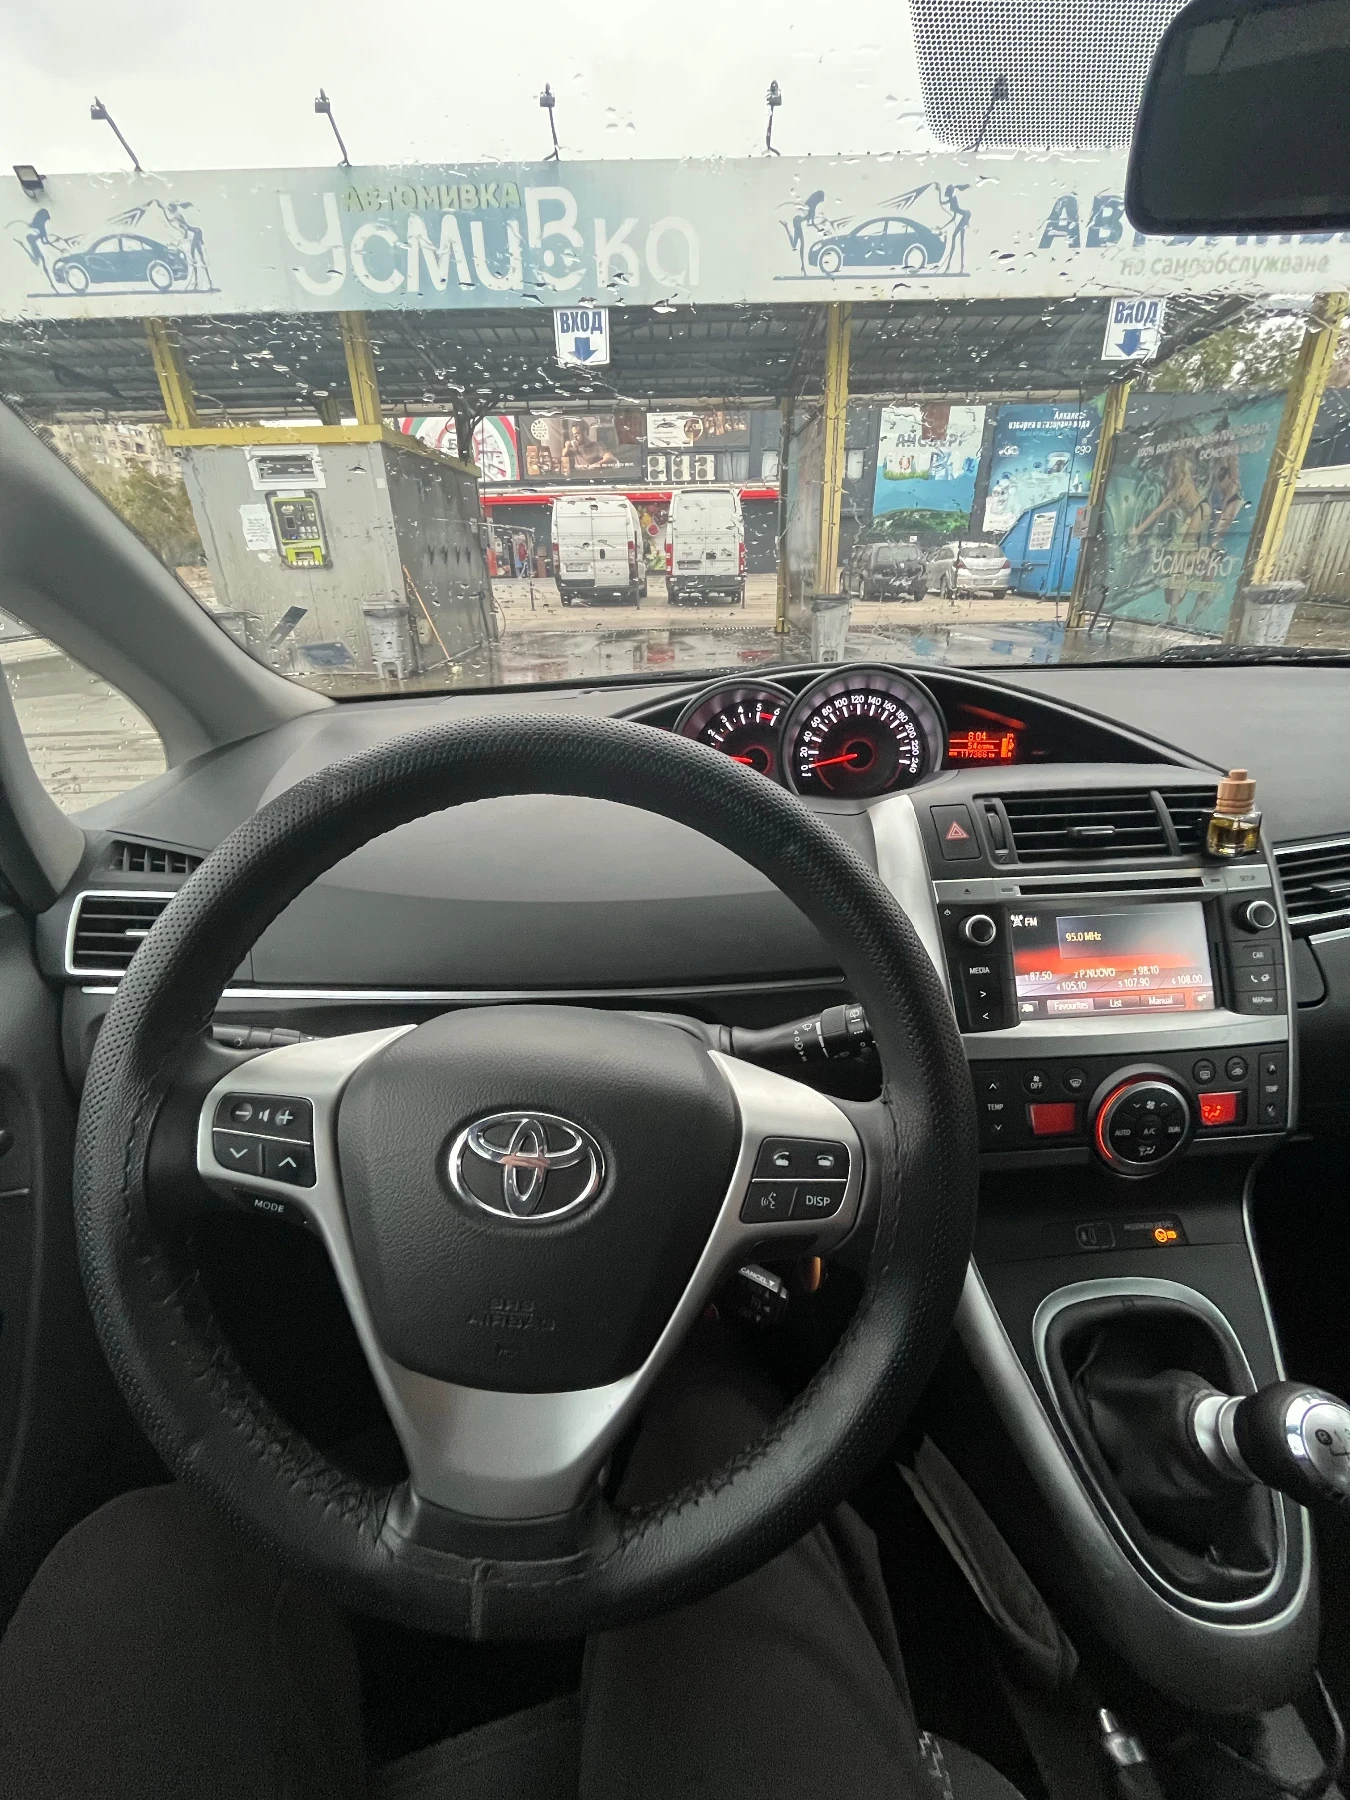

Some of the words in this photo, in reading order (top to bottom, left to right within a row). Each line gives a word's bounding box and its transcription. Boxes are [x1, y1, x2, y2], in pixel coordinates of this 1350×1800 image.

[343, 181, 523, 212] АВТОМИВКА
[1113, 301, 1160, 325] ВХОД
[560, 310, 603, 335] ВХОД
[1074, 445, 1092, 456] ego
[833, 697, 848, 709] 100
[850, 695, 864, 704] 120
[867, 695, 882, 707] 140
[737, 705, 744, 713] 4
[756, 703, 763, 711] 5
[773, 707, 781, 716] 6
[821, 705, 833, 717] 80
[882, 699, 897, 713] 160
[720, 714, 728, 723] 3
[895, 708, 909, 723] 180
[810, 716, 821, 728] 60
[708, 728, 716, 737] 2
[904, 722, 917, 739] 200
[803, 730, 813, 743] 40
[800, 746, 808, 758] 20
[910, 739, 919, 756] 220
[908, 757, 919, 774] 240
[1024, 917, 1038, 927] FM
[1065, 933, 1083, 942] 95.0
[1084, 931, 1102, 941] MHz
[969, 966, 990, 975] MEDIA
[1029, 970, 1053, 981] 87.50
[1132, 968, 1137, 976] 3
[1137, 965, 1160, 975] 98.10
[1123, 977, 1150, 988] 107.90
[1177, 974, 1203, 984] 108.00
[1061, 980, 1087, 991] 105.10
[1054, 1000, 1089, 1011] Favourites
[1109, 999, 1123, 1008] List
[1148, 995, 1174, 1005] Manual
[1030, 1081, 1043, 1090] OFF
[987, 1103, 1004, 1111] TEMP
[1114, 1128, 1131, 1136] AUTO
[1142, 1127, 1157, 1136] A/C
[1167, 1125, 1182, 1134] DUAL
[254, 1199, 285, 1213] MODE
[805, 1195, 831, 1206] DISP
[740, 1266, 768, 1286] CANCEL
